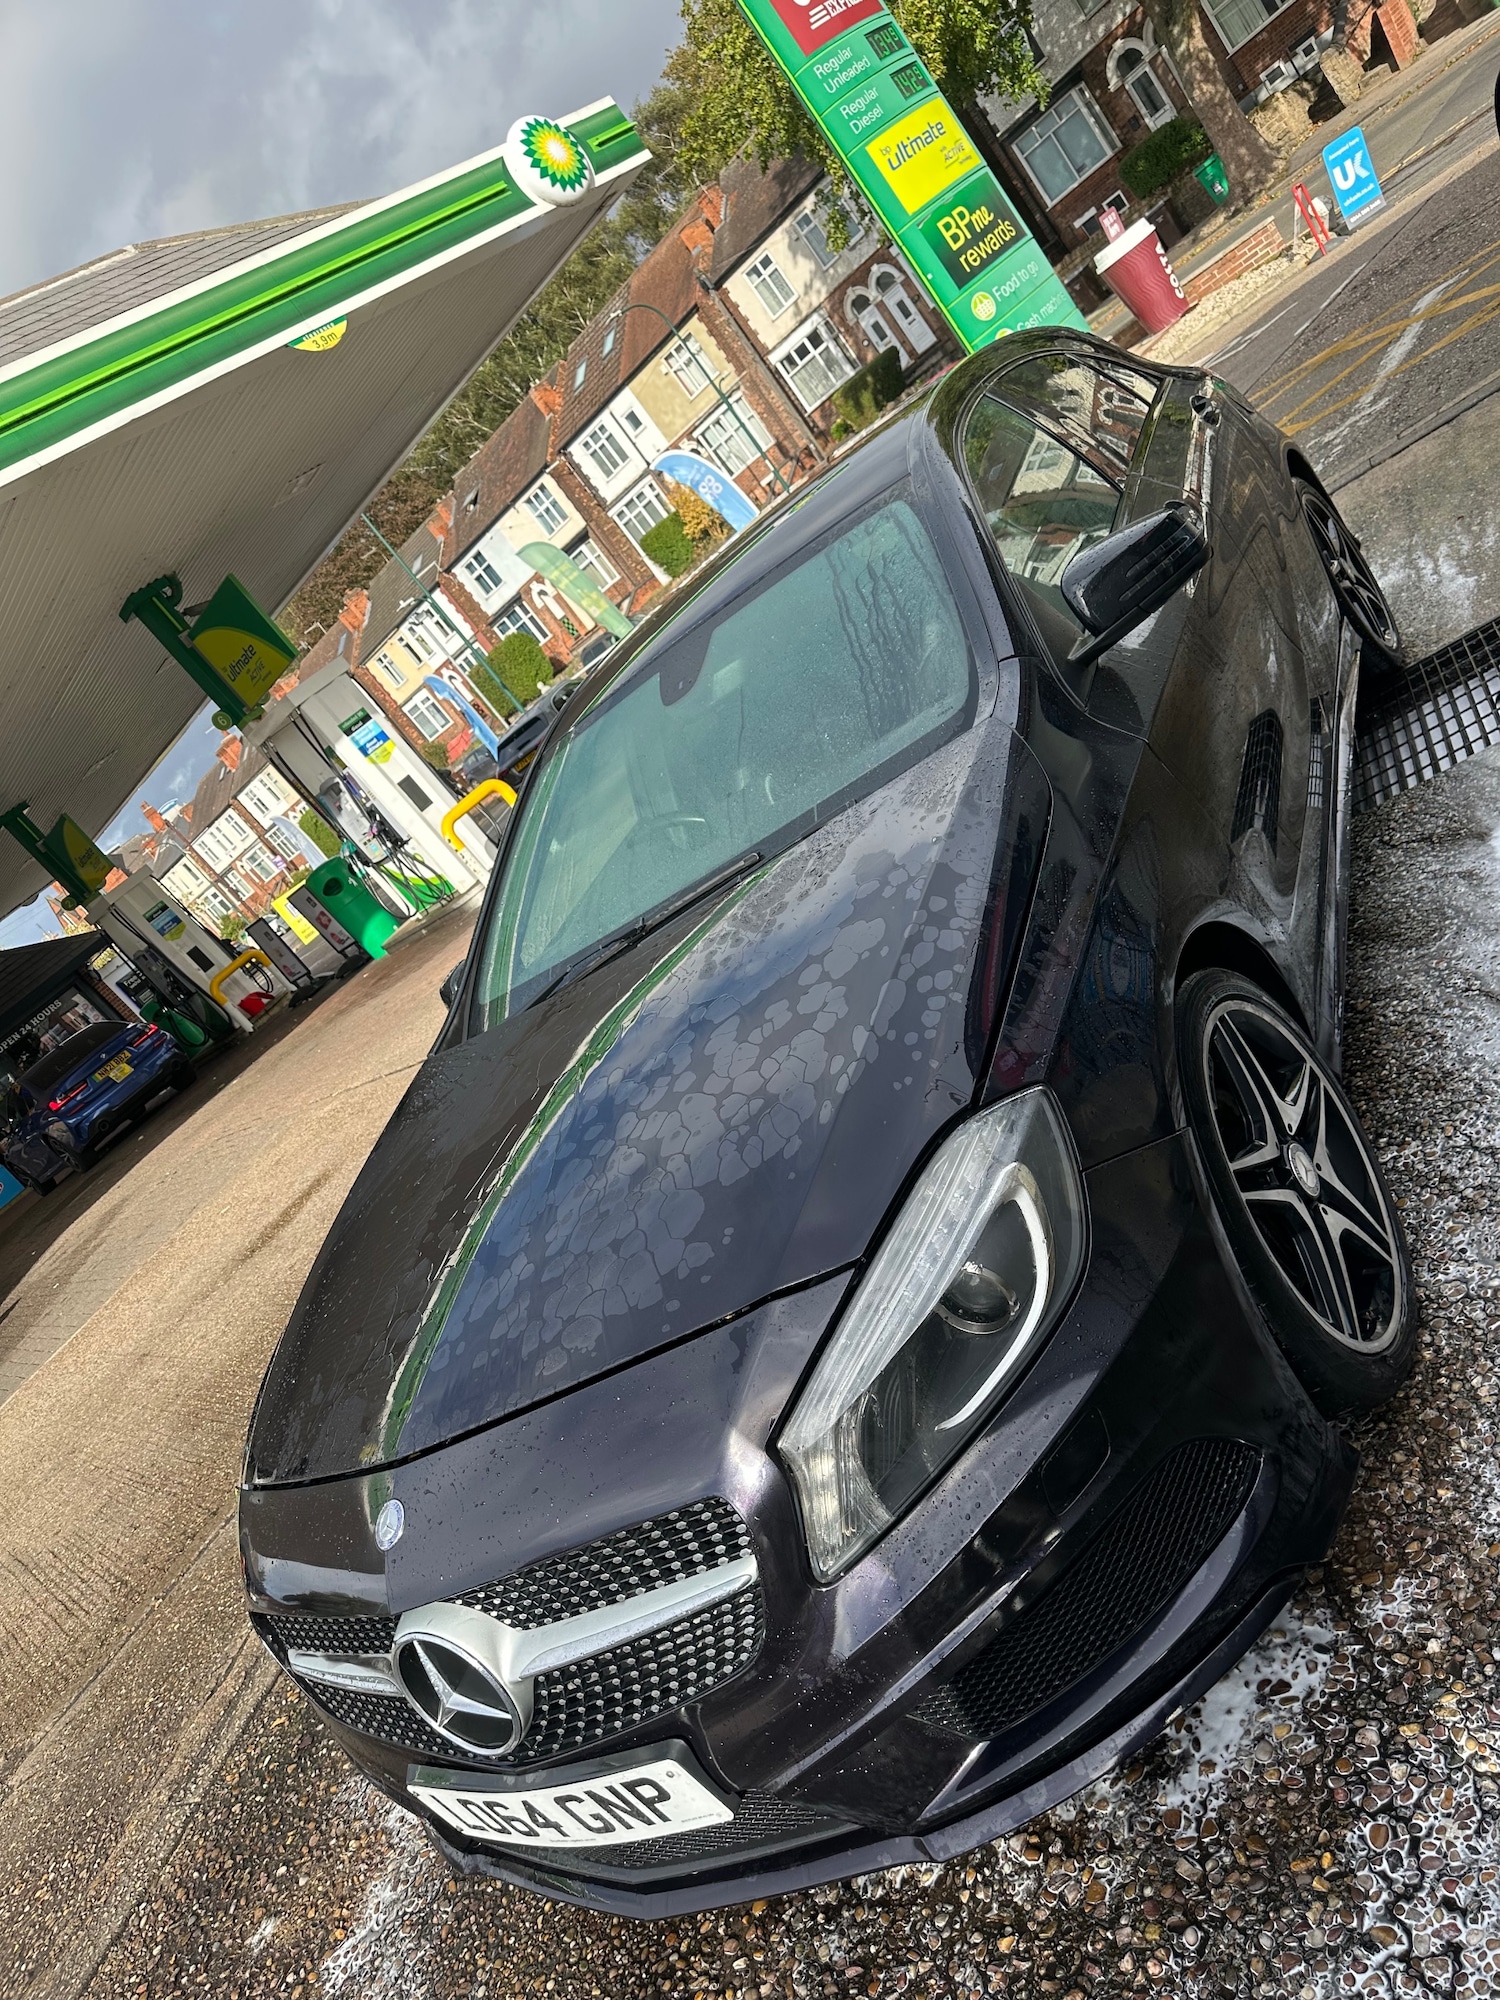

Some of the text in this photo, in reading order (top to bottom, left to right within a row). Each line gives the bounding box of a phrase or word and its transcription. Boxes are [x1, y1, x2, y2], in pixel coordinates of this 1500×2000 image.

[813, 47, 853, 79] Regular
[823, 55, 871, 94] Unleaded
[840, 87, 879, 120] Regular
[849, 103, 884, 135] Diesel
[887, 121, 946, 171] ultimate
[959, 219, 1016, 273] rewards
[992, 260, 1039, 302] Food to go
[1155, 242, 1184, 299] COSTA
[227, 644, 257, 682] ultimate
[217, 715, 227, 726] 6
[19, 1023, 32, 1035] 24
[30, 999, 62, 1026] HOURS
[428, 1776, 672, 1838] LO64 GNP
